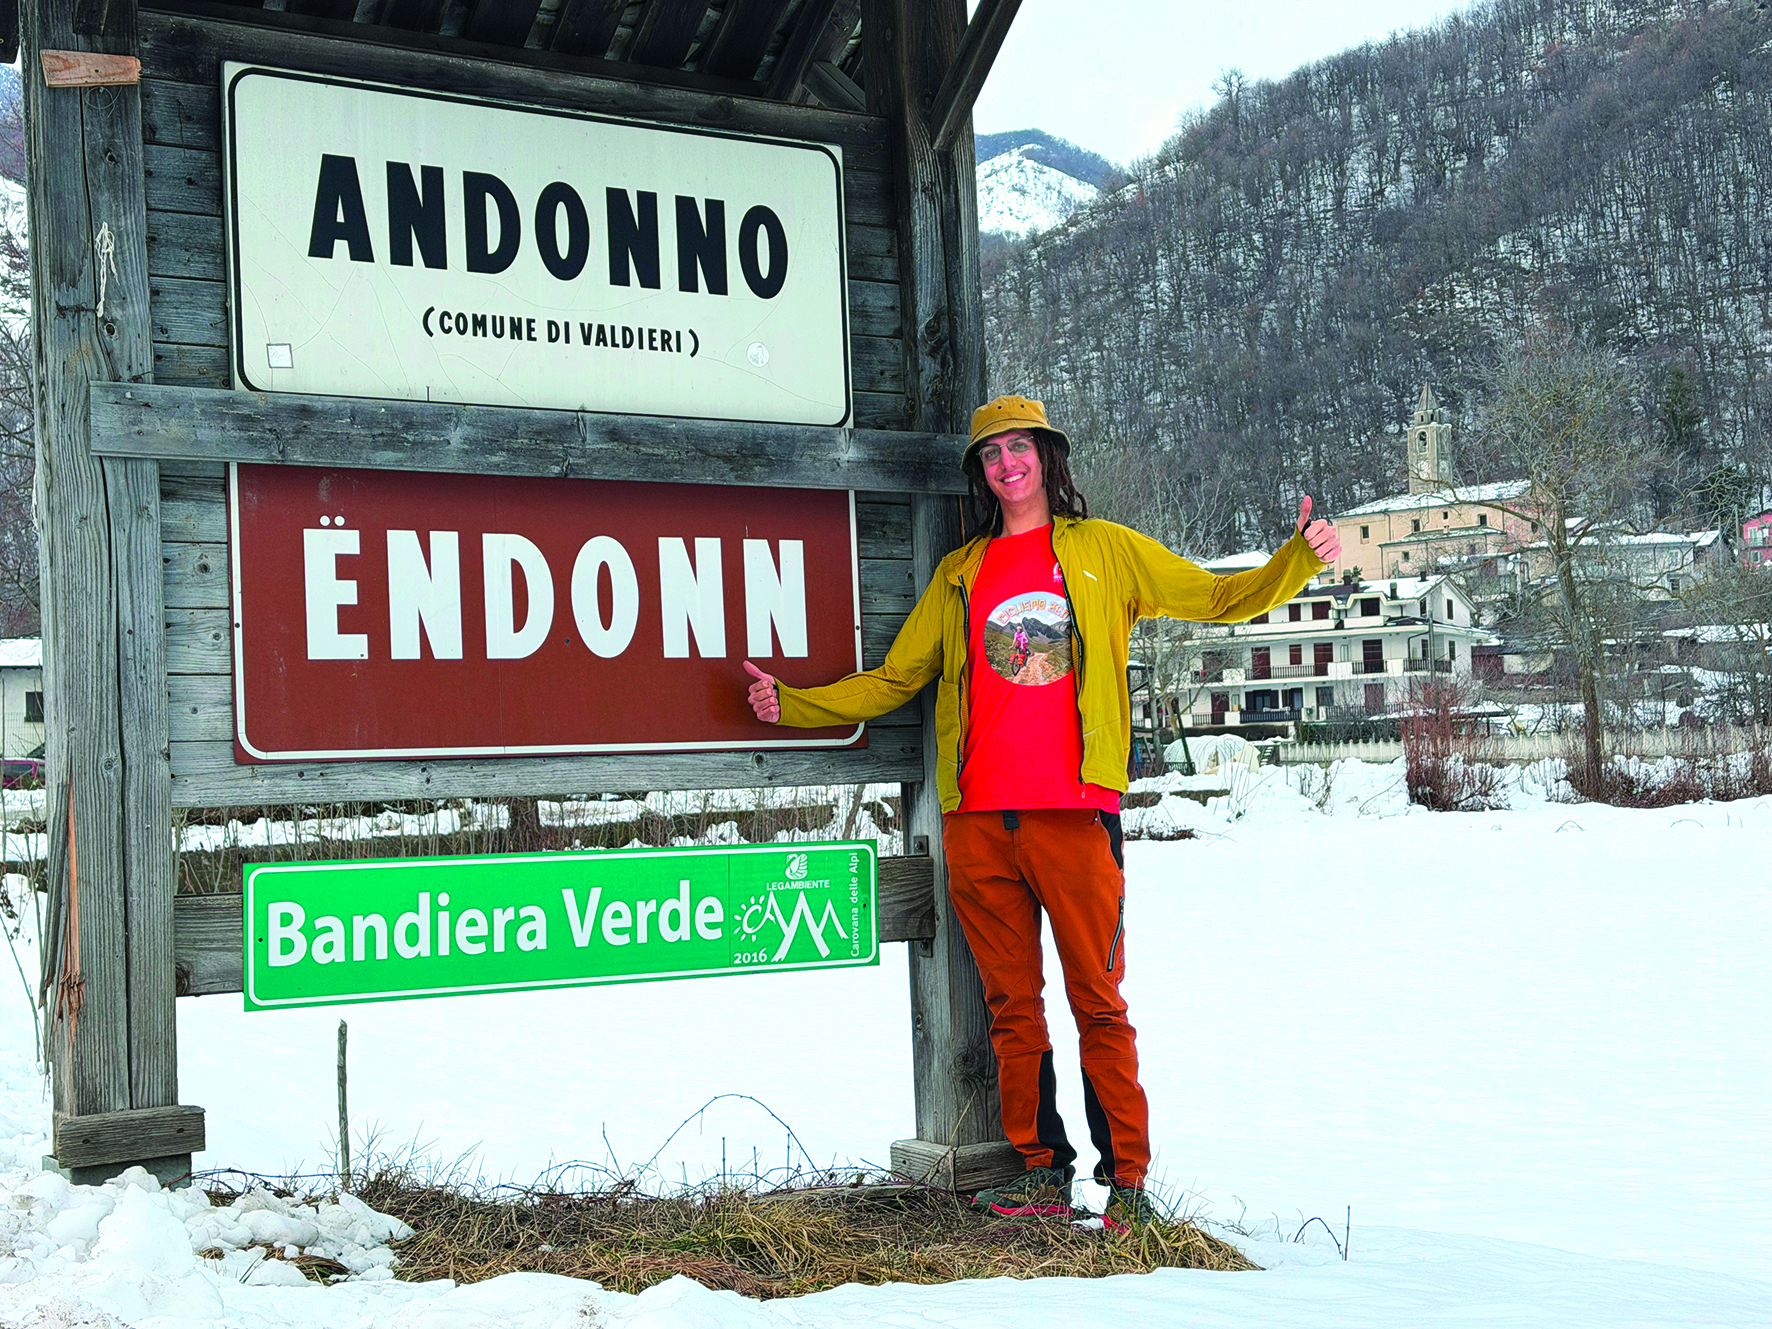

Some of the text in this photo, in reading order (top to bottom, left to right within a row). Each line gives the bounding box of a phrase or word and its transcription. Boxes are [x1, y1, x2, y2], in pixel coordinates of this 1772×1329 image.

[307, 153, 789, 300] ANDONNO
[422, 306, 700, 358] (COMUNE DI VALDIERI)
[302, 515, 809, 660] ËNDONN
[268, 880, 724, 967] Bandiera Verde
[766, 879, 830, 891] LEGAMBIENTE
[849, 852, 860, 957] Carovana delle Alpi
[733, 947, 768, 964] 2016
